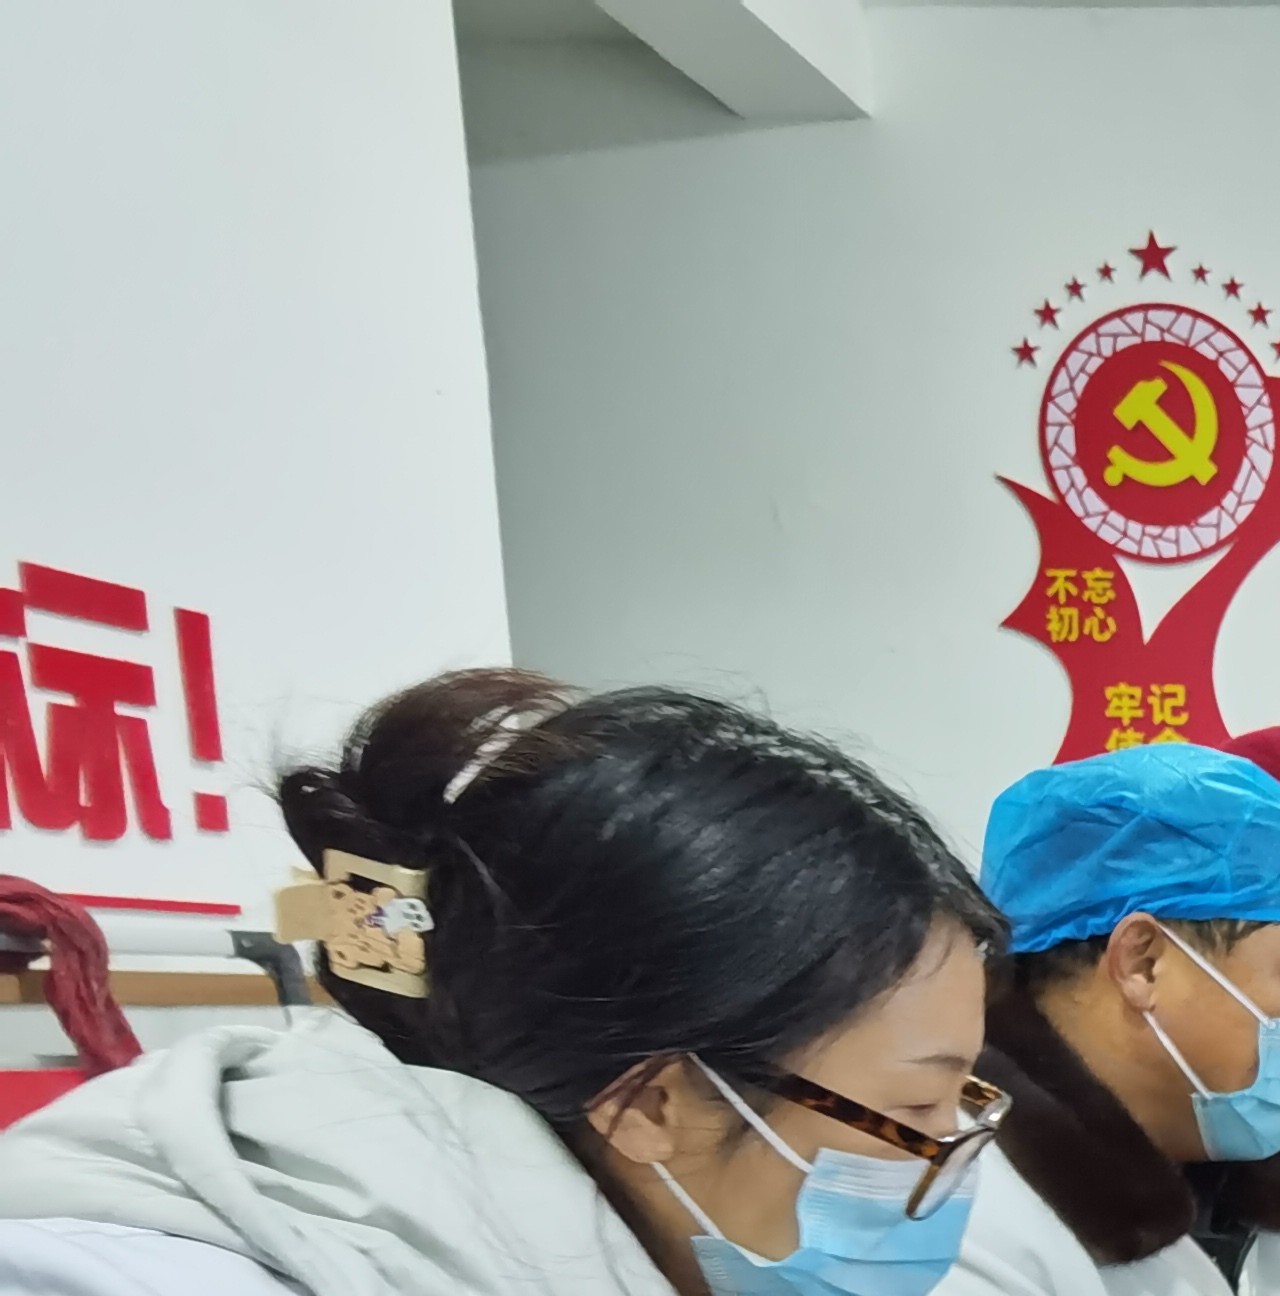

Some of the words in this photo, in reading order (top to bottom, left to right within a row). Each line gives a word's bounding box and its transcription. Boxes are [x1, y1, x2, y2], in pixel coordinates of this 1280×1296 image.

[1045, 567, 1116, 604] 不忘
[1045, 606, 1117, 643] 初心
[1104, 682, 1189, 726] 牢记
